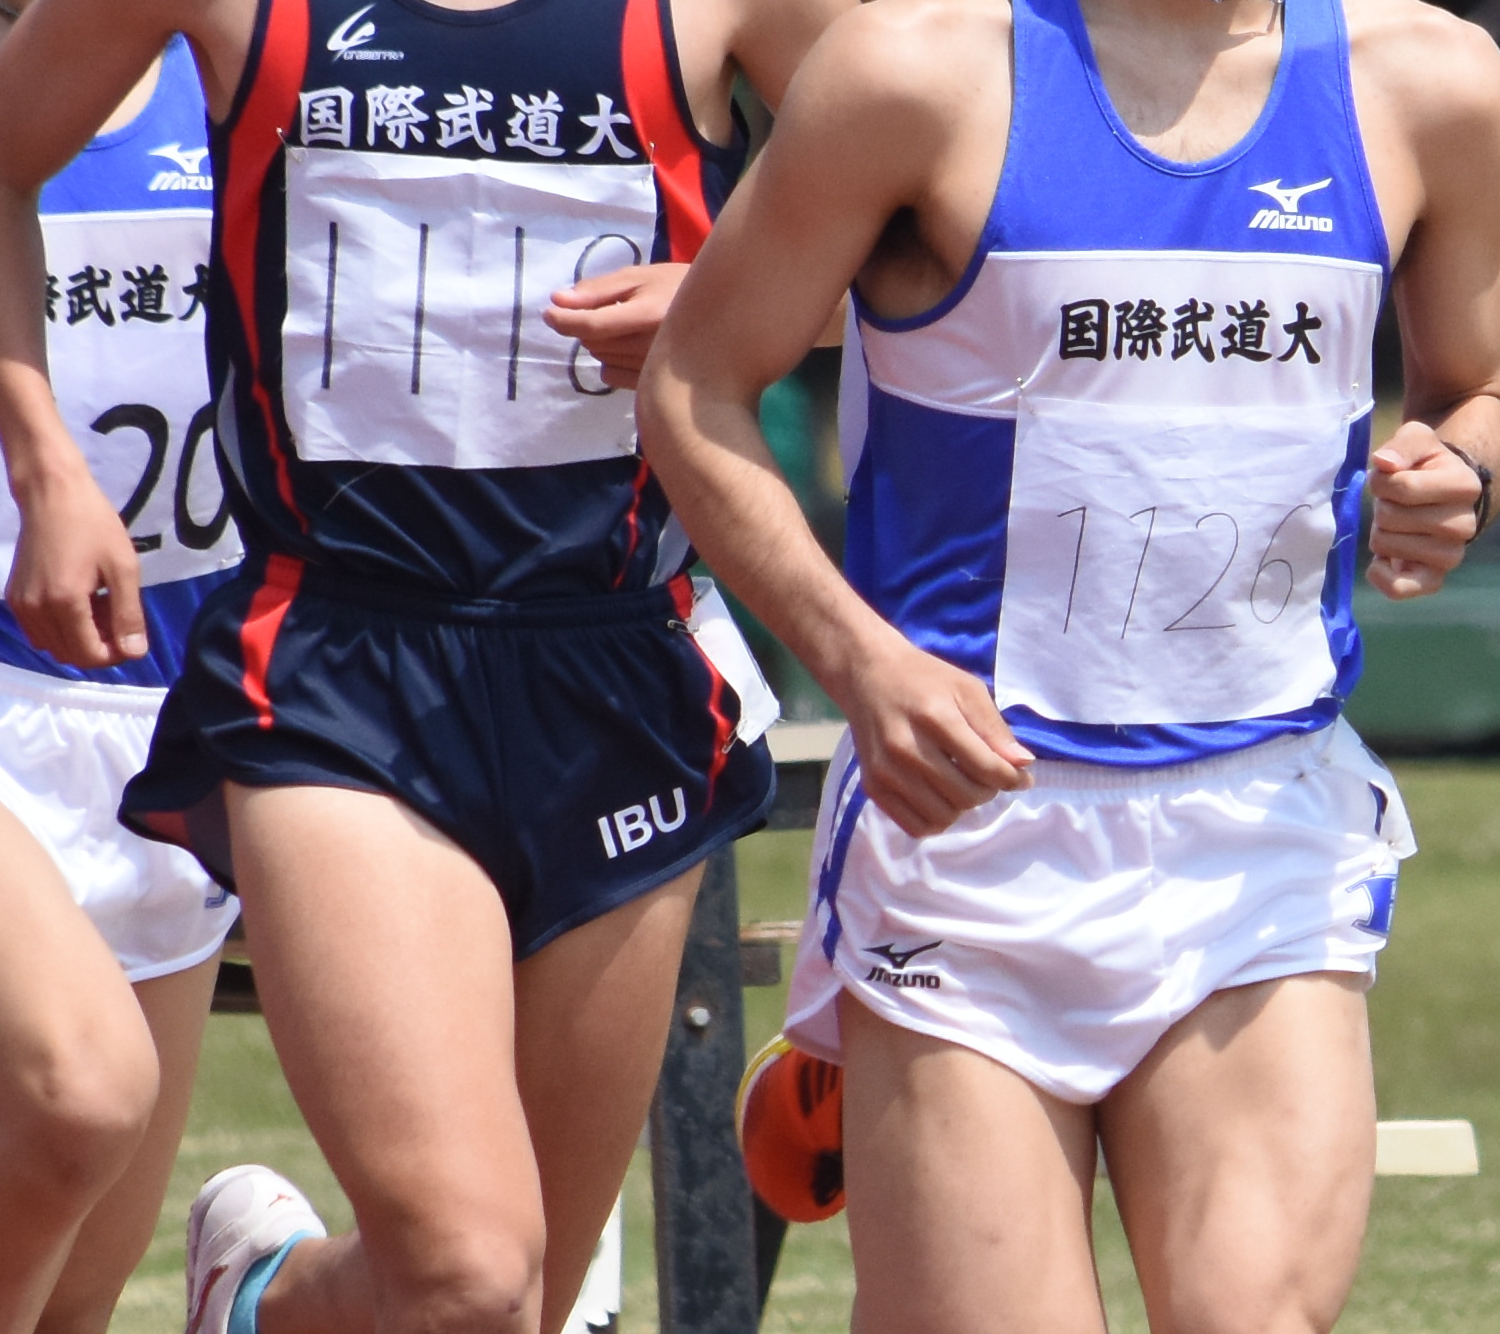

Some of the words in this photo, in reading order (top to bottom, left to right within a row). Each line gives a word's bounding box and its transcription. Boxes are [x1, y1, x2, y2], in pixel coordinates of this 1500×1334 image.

[299, 84, 637, 158] 国際武道大
[1248, 209, 1333, 233] MIZUNO
[1058, 298, 1323, 365] 国際武道大
[1057, 503, 1313, 640] 1126
[597, 787, 687, 860] IBU
